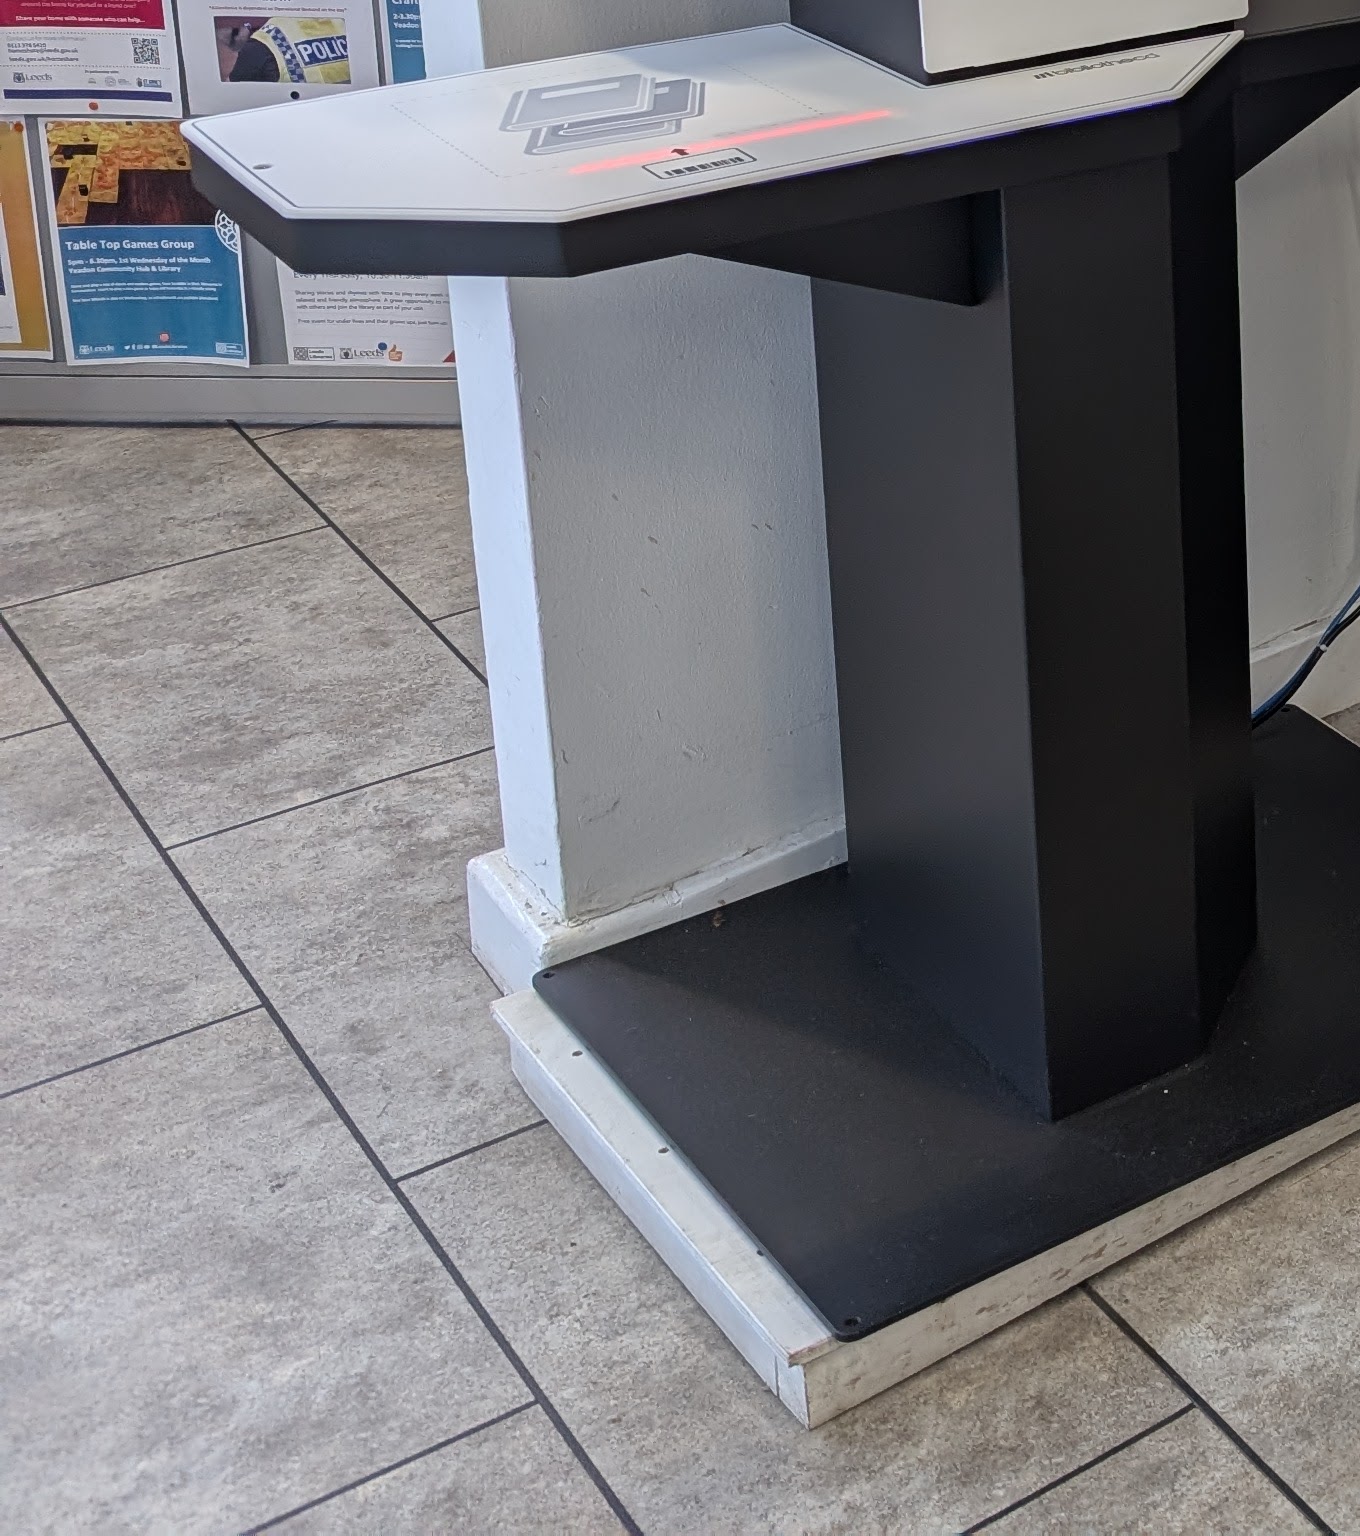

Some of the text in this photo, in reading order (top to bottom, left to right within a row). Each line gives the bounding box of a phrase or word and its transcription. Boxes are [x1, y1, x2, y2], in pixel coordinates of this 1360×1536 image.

[65, 240, 194, 250] Table Top Games Group
[354, 349, 384, 357] Leeds
